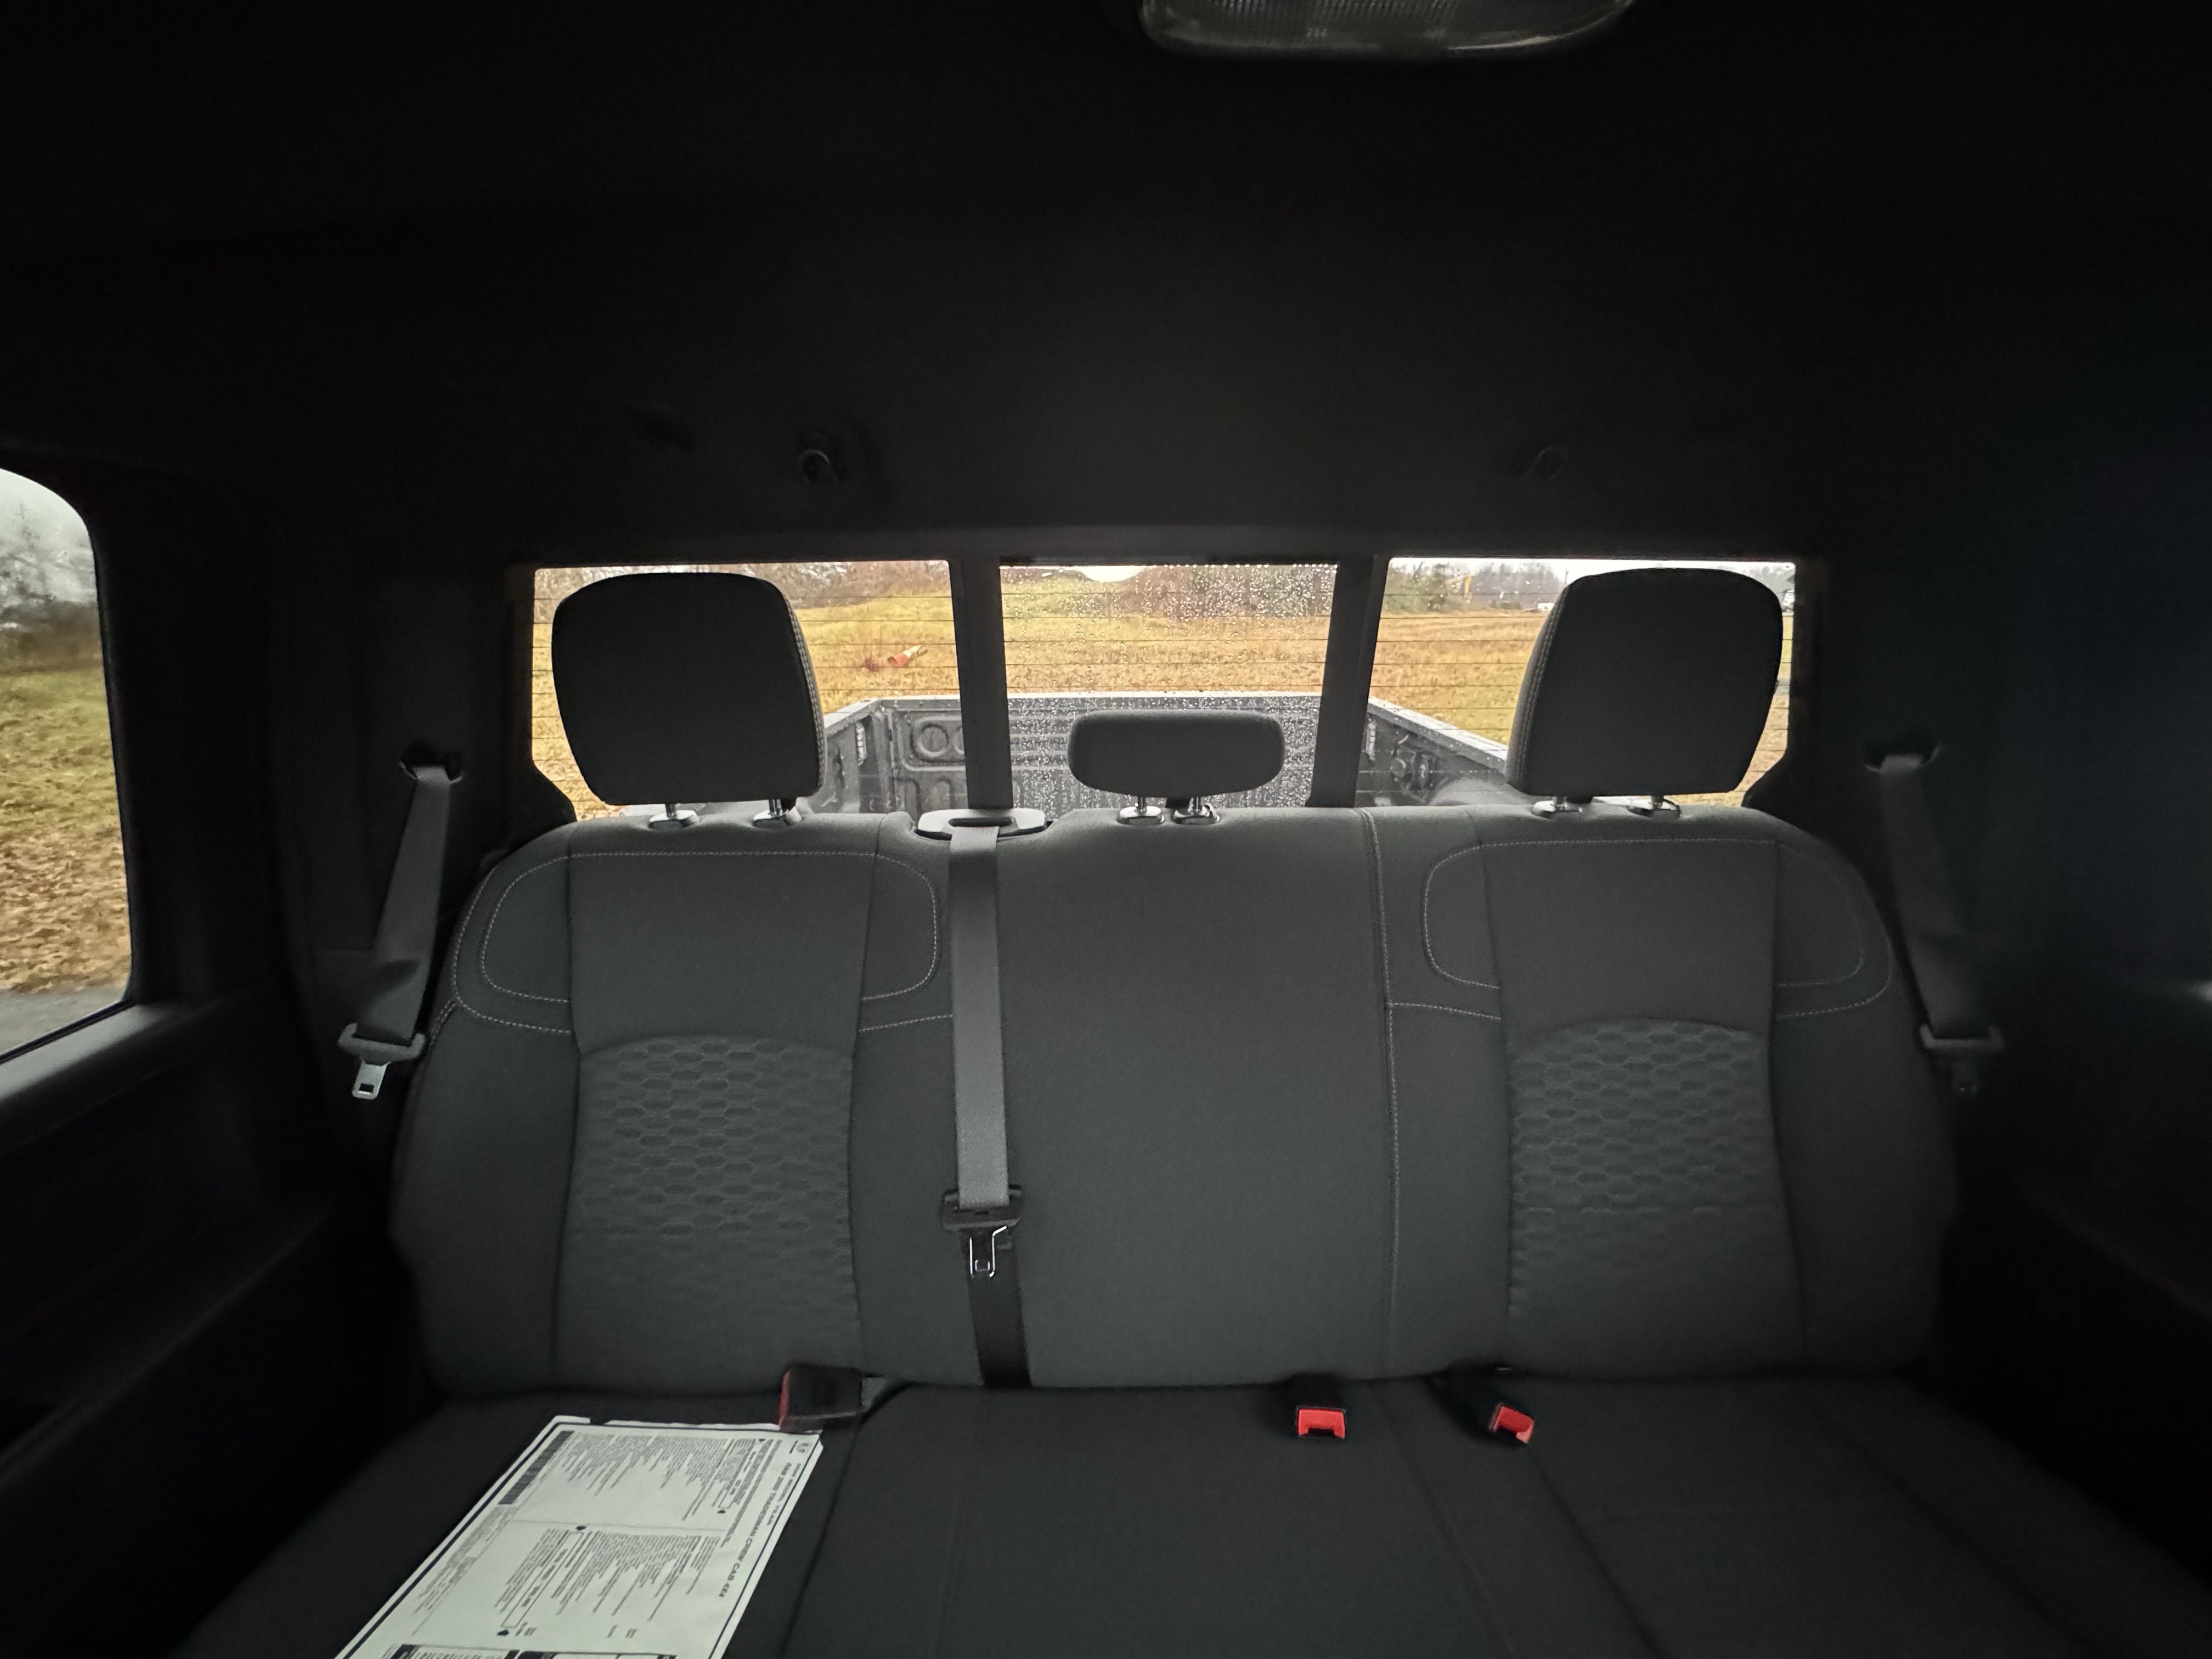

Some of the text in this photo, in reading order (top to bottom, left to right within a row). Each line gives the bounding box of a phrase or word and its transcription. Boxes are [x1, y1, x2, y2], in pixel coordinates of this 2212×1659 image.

[749, 1492, 776, 1537] TRADESMAN
[737, 1538, 753, 1562] CREW
[727, 1563, 740, 1581] CAB
